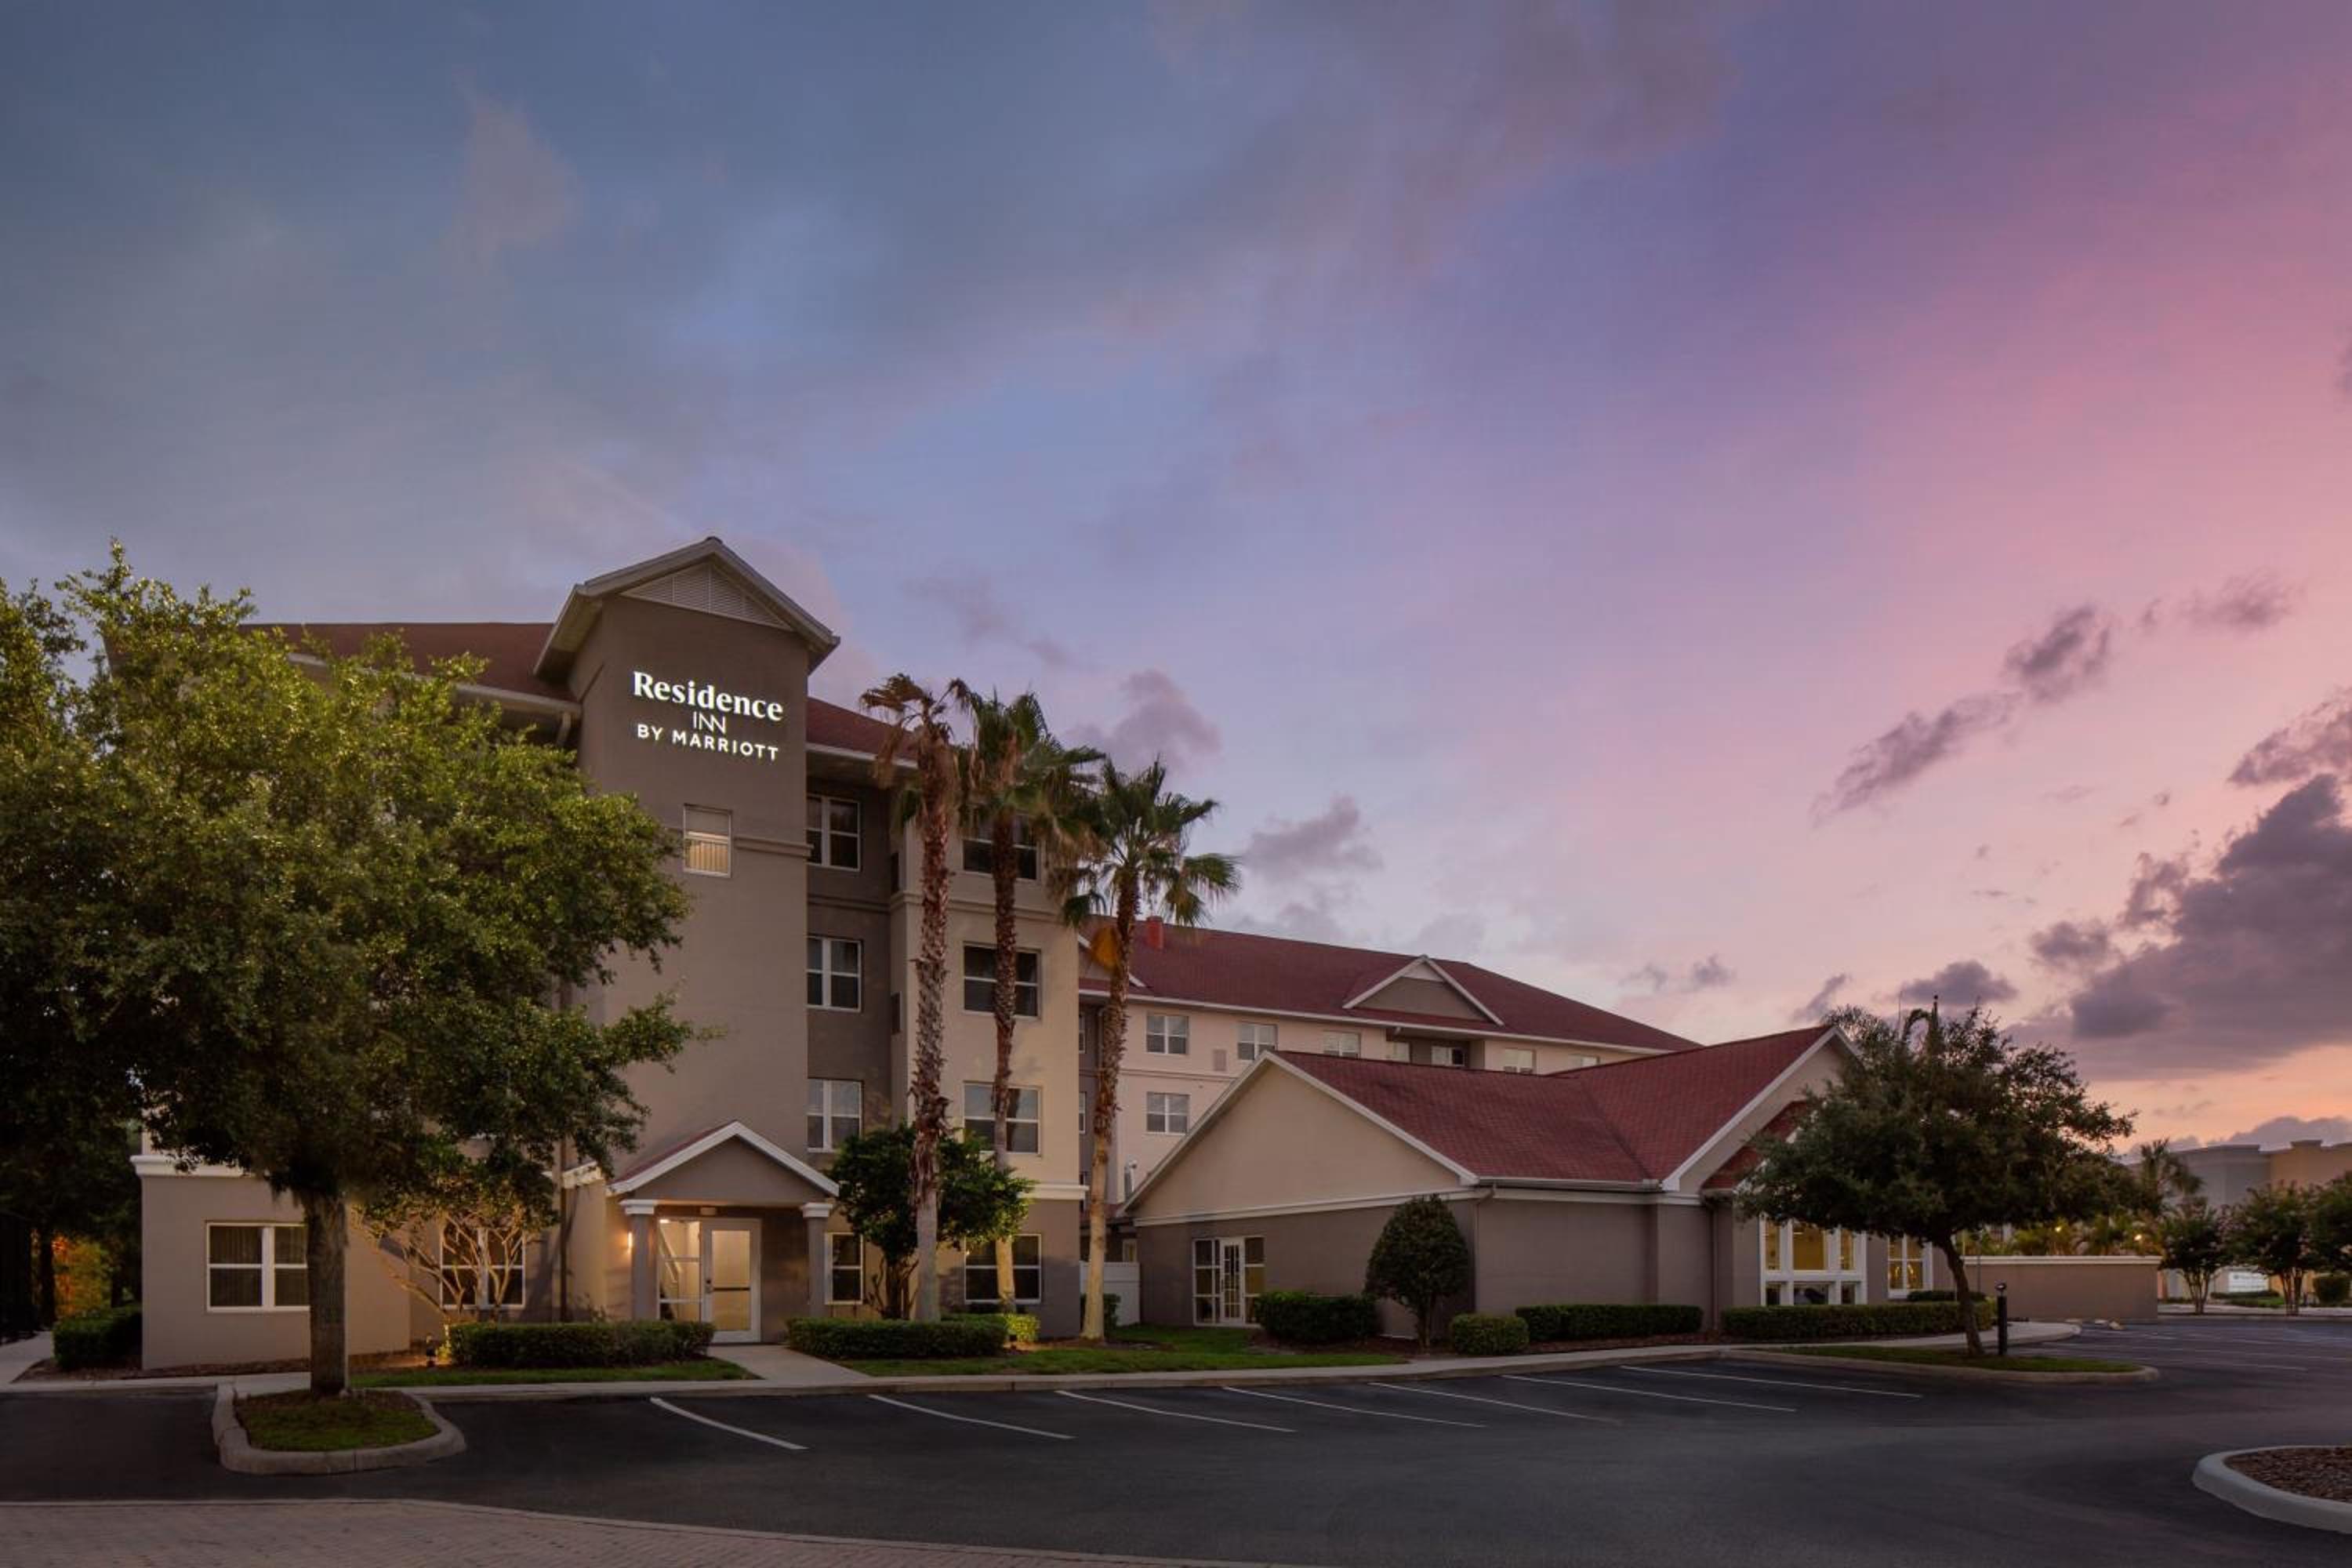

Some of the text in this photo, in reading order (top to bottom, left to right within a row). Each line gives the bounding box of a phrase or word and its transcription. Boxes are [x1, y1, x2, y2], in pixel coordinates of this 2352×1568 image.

[633, 671, 783, 721] Residence
[693, 711, 726, 734] INN
[637, 724, 779, 760] BY MARRIOTT
